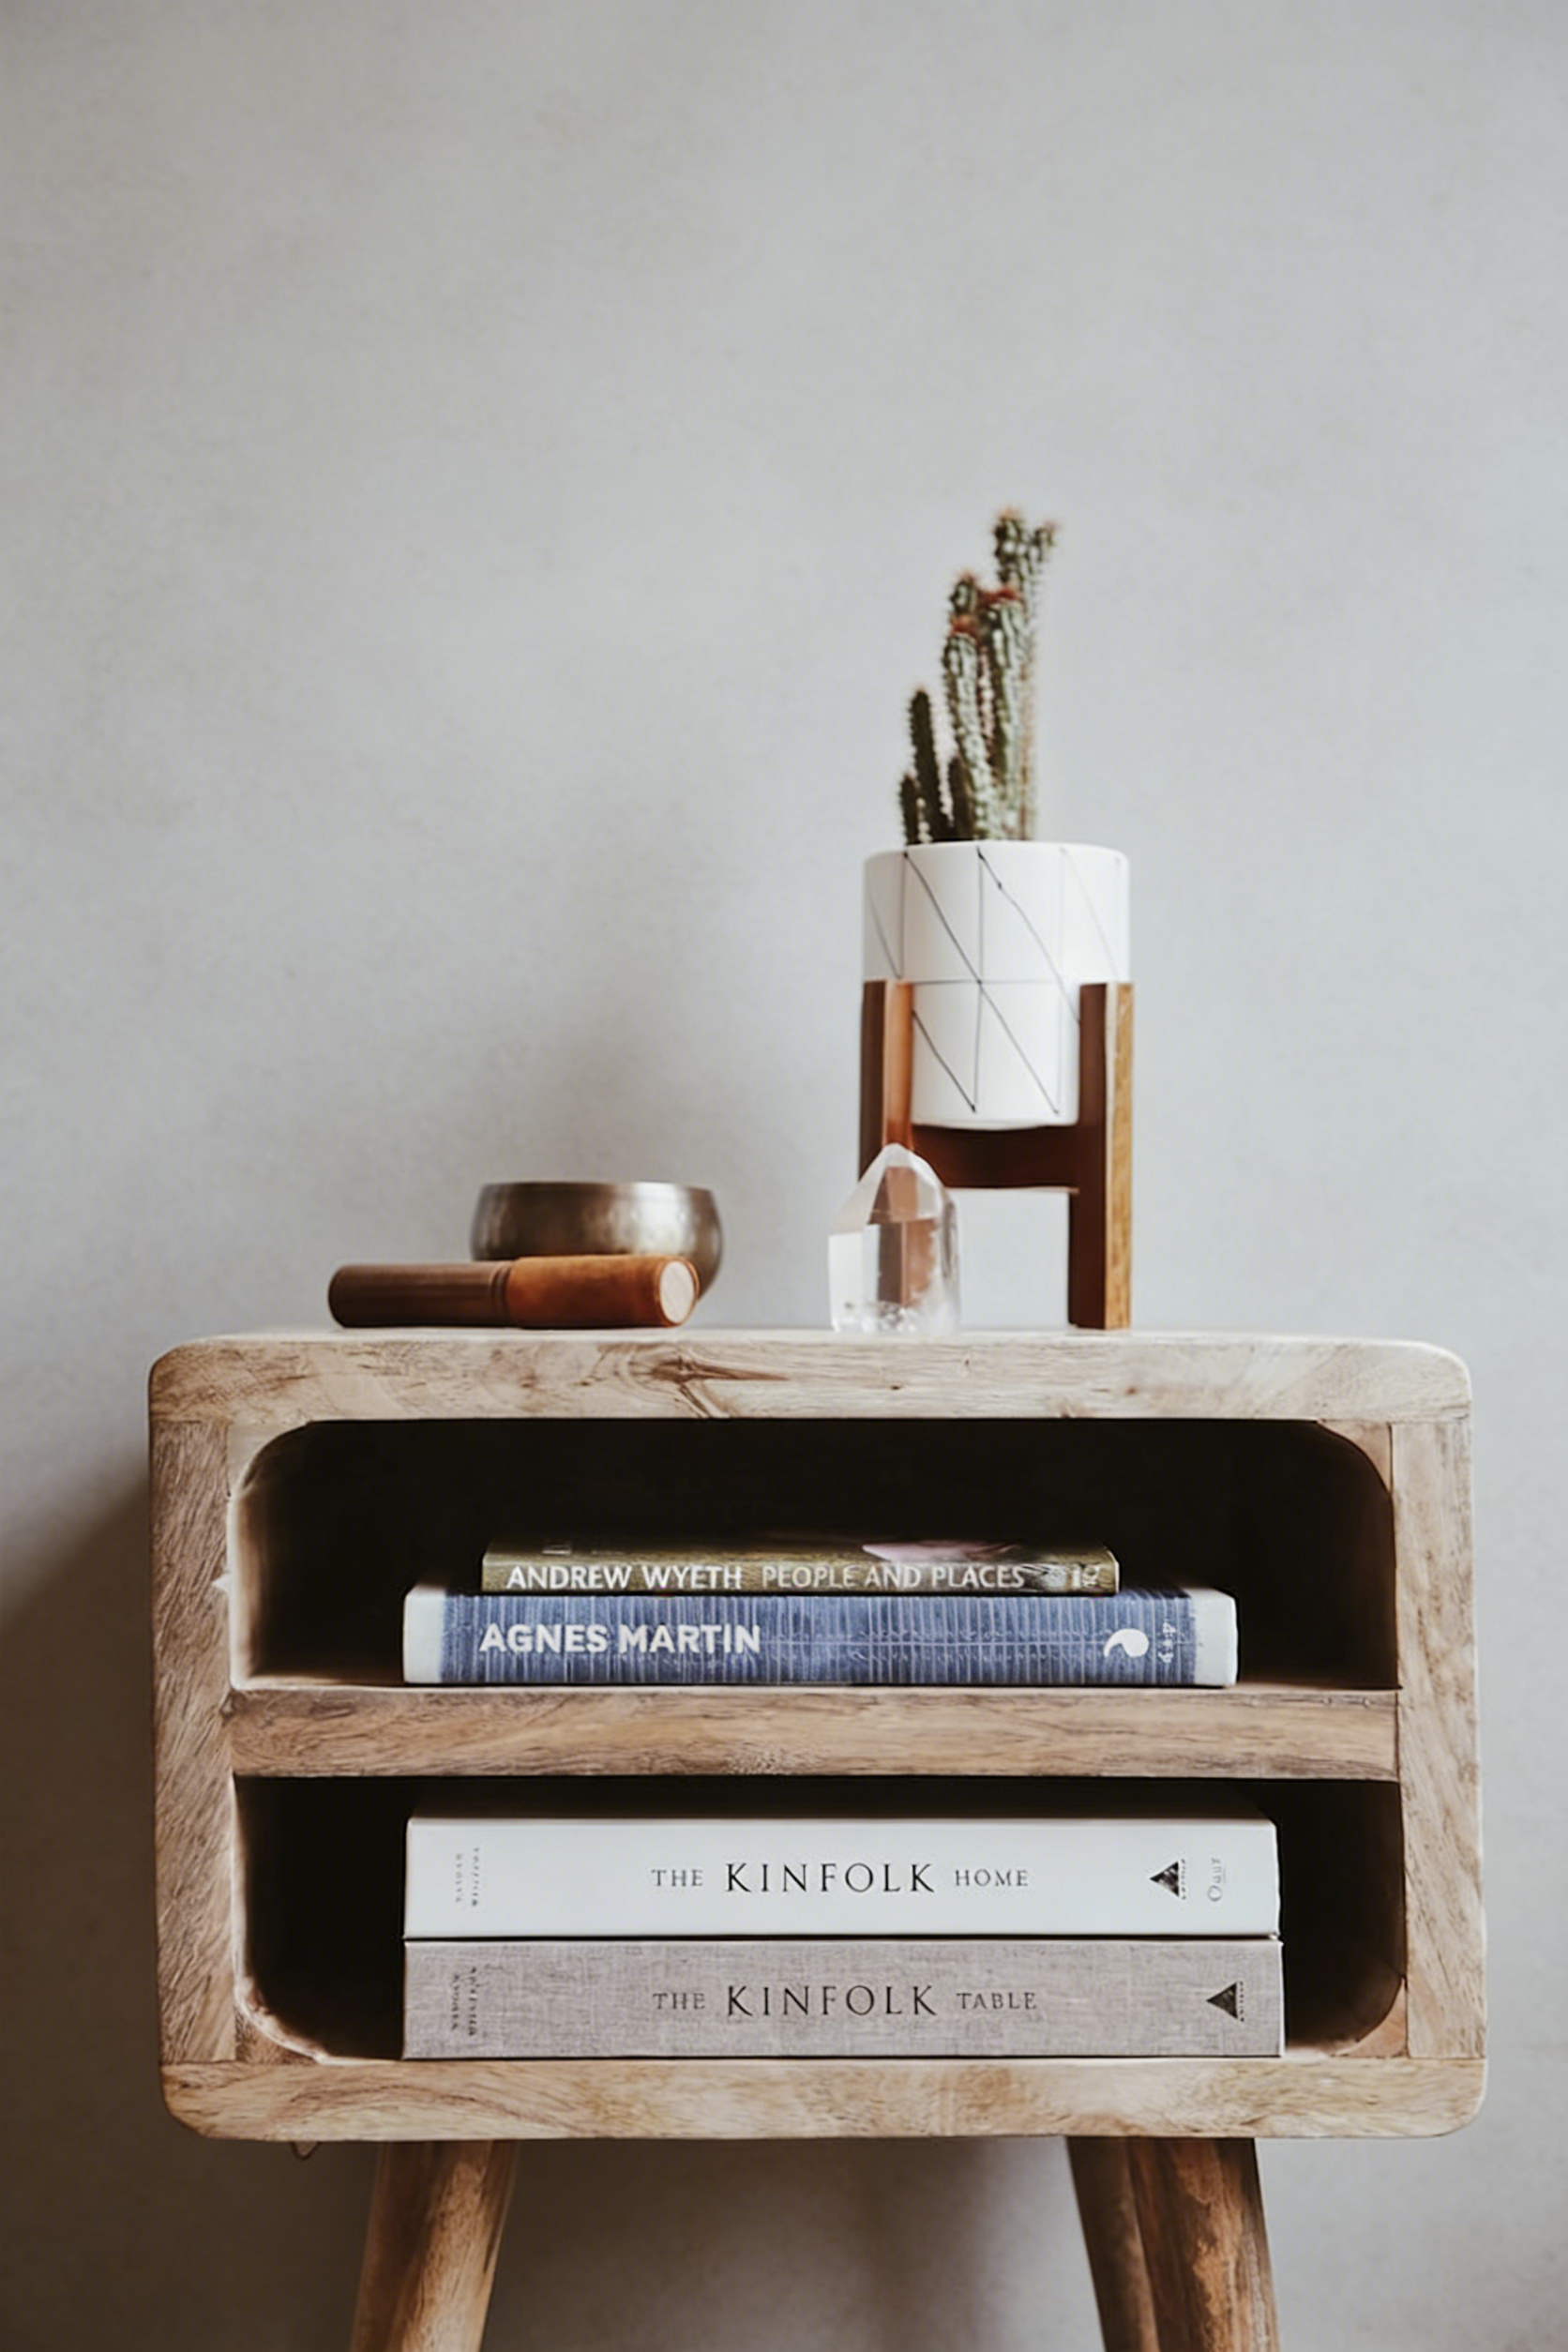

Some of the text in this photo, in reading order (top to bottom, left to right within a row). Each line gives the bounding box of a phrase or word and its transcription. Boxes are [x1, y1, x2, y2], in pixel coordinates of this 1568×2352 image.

[505, 1565, 1025, 1590] ANDREW WYETH PEOPLE AND PLACES
[479, 1623, 761, 1653] AGNES MARTIN
[651, 1862, 1030, 1892] THE KINFOLK HOME
[653, 1985, 1037, 2016] THE KINFOLK TABLE
